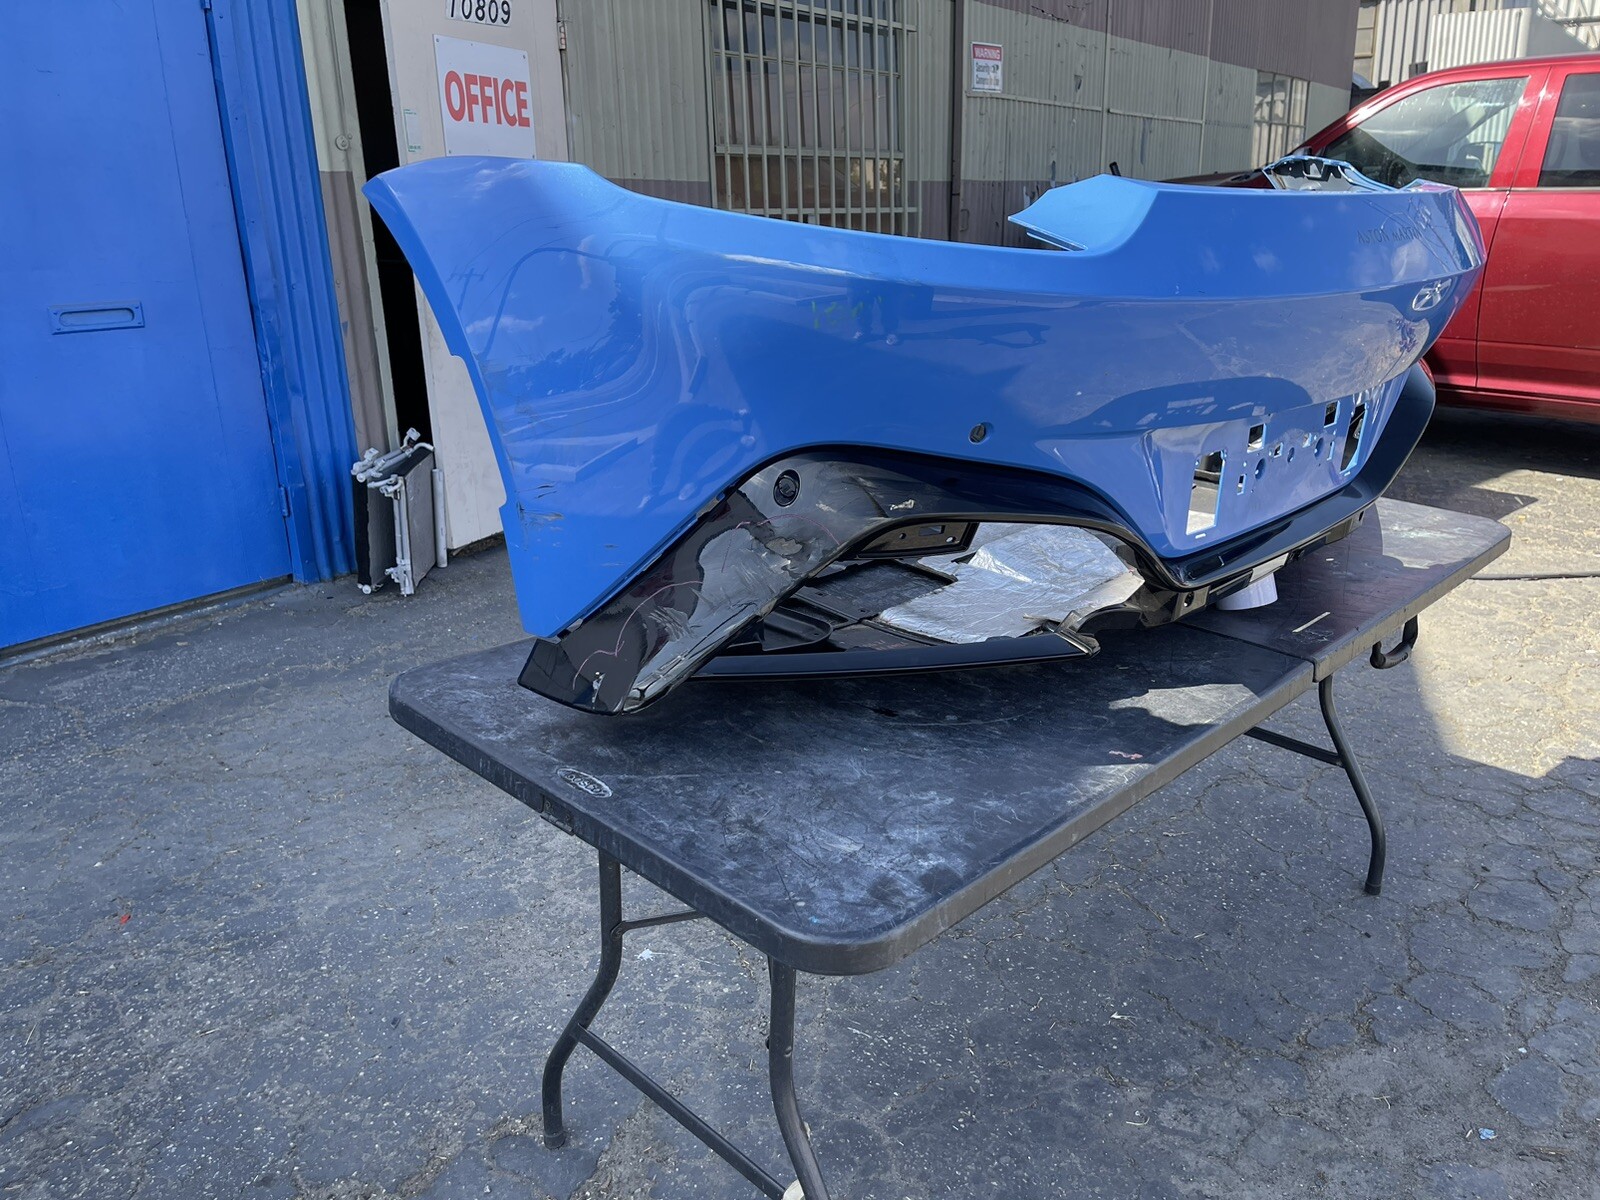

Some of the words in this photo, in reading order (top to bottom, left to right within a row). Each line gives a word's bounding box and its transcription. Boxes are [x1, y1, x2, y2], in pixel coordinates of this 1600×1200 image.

[974, 47, 1001, 60] WARNING
[444, 70, 531, 127] OFFICE
[1357, 228, 1390, 244] ASTON
